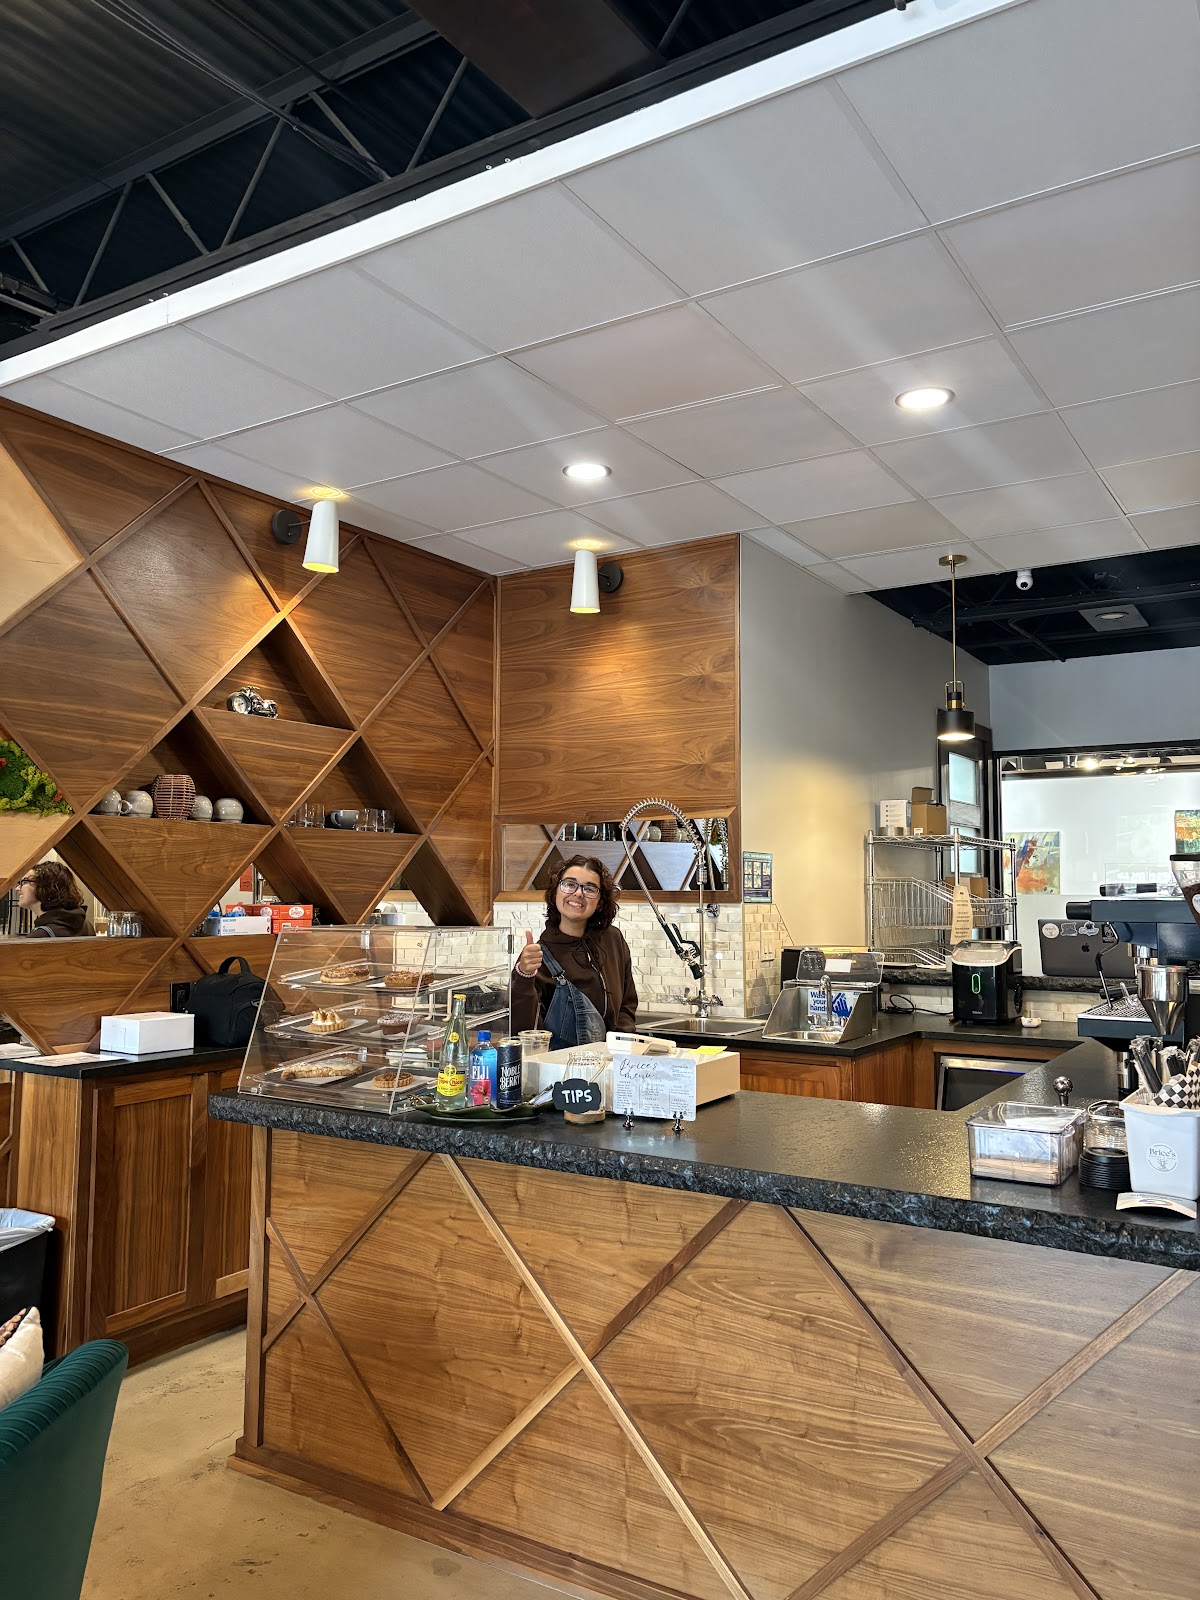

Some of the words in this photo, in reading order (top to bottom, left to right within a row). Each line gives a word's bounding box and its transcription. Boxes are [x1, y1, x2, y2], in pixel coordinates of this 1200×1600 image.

[810, 1004, 827, 1012] hand
[472, 1066, 489, 1080] FIJI
[500, 1064, 521, 1078] NOBLE
[499, 1074, 520, 1090] BERRY
[561, 1090, 592, 1104] TIPS
[1149, 1148, 1176, 1157] Brice's
